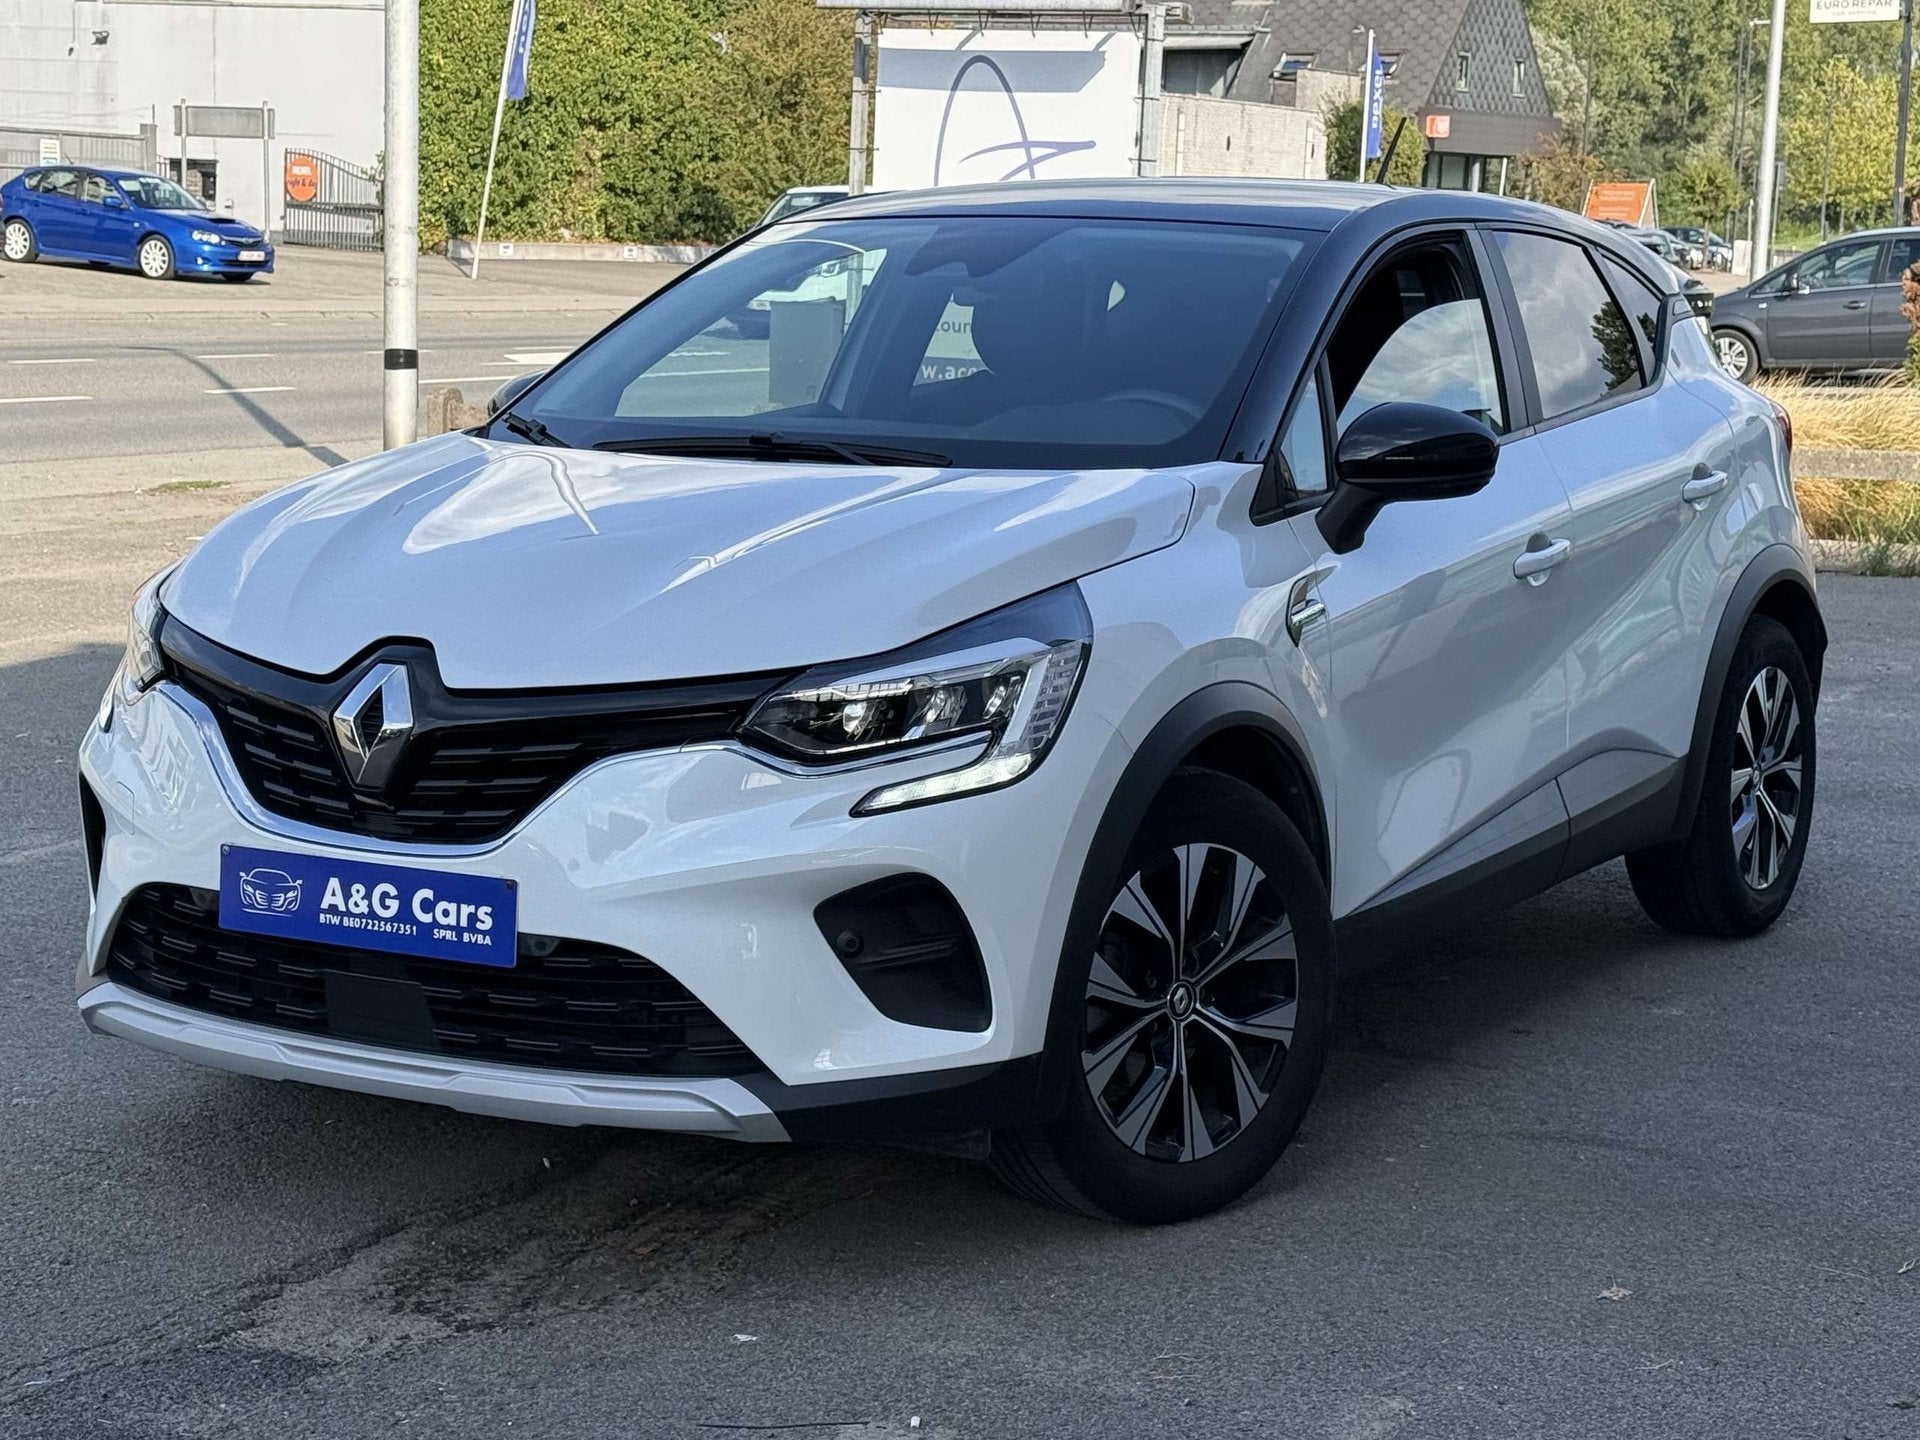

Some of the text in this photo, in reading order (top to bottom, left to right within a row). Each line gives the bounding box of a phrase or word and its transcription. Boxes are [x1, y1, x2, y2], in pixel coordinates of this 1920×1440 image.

[1816, 0, 1850, 10] EURO
[936, 321, 972, 333] oun
[320, 877, 493, 931] A&G Cars
[319, 913, 492, 946] BTW BE0722567351 SPRL BVBA
